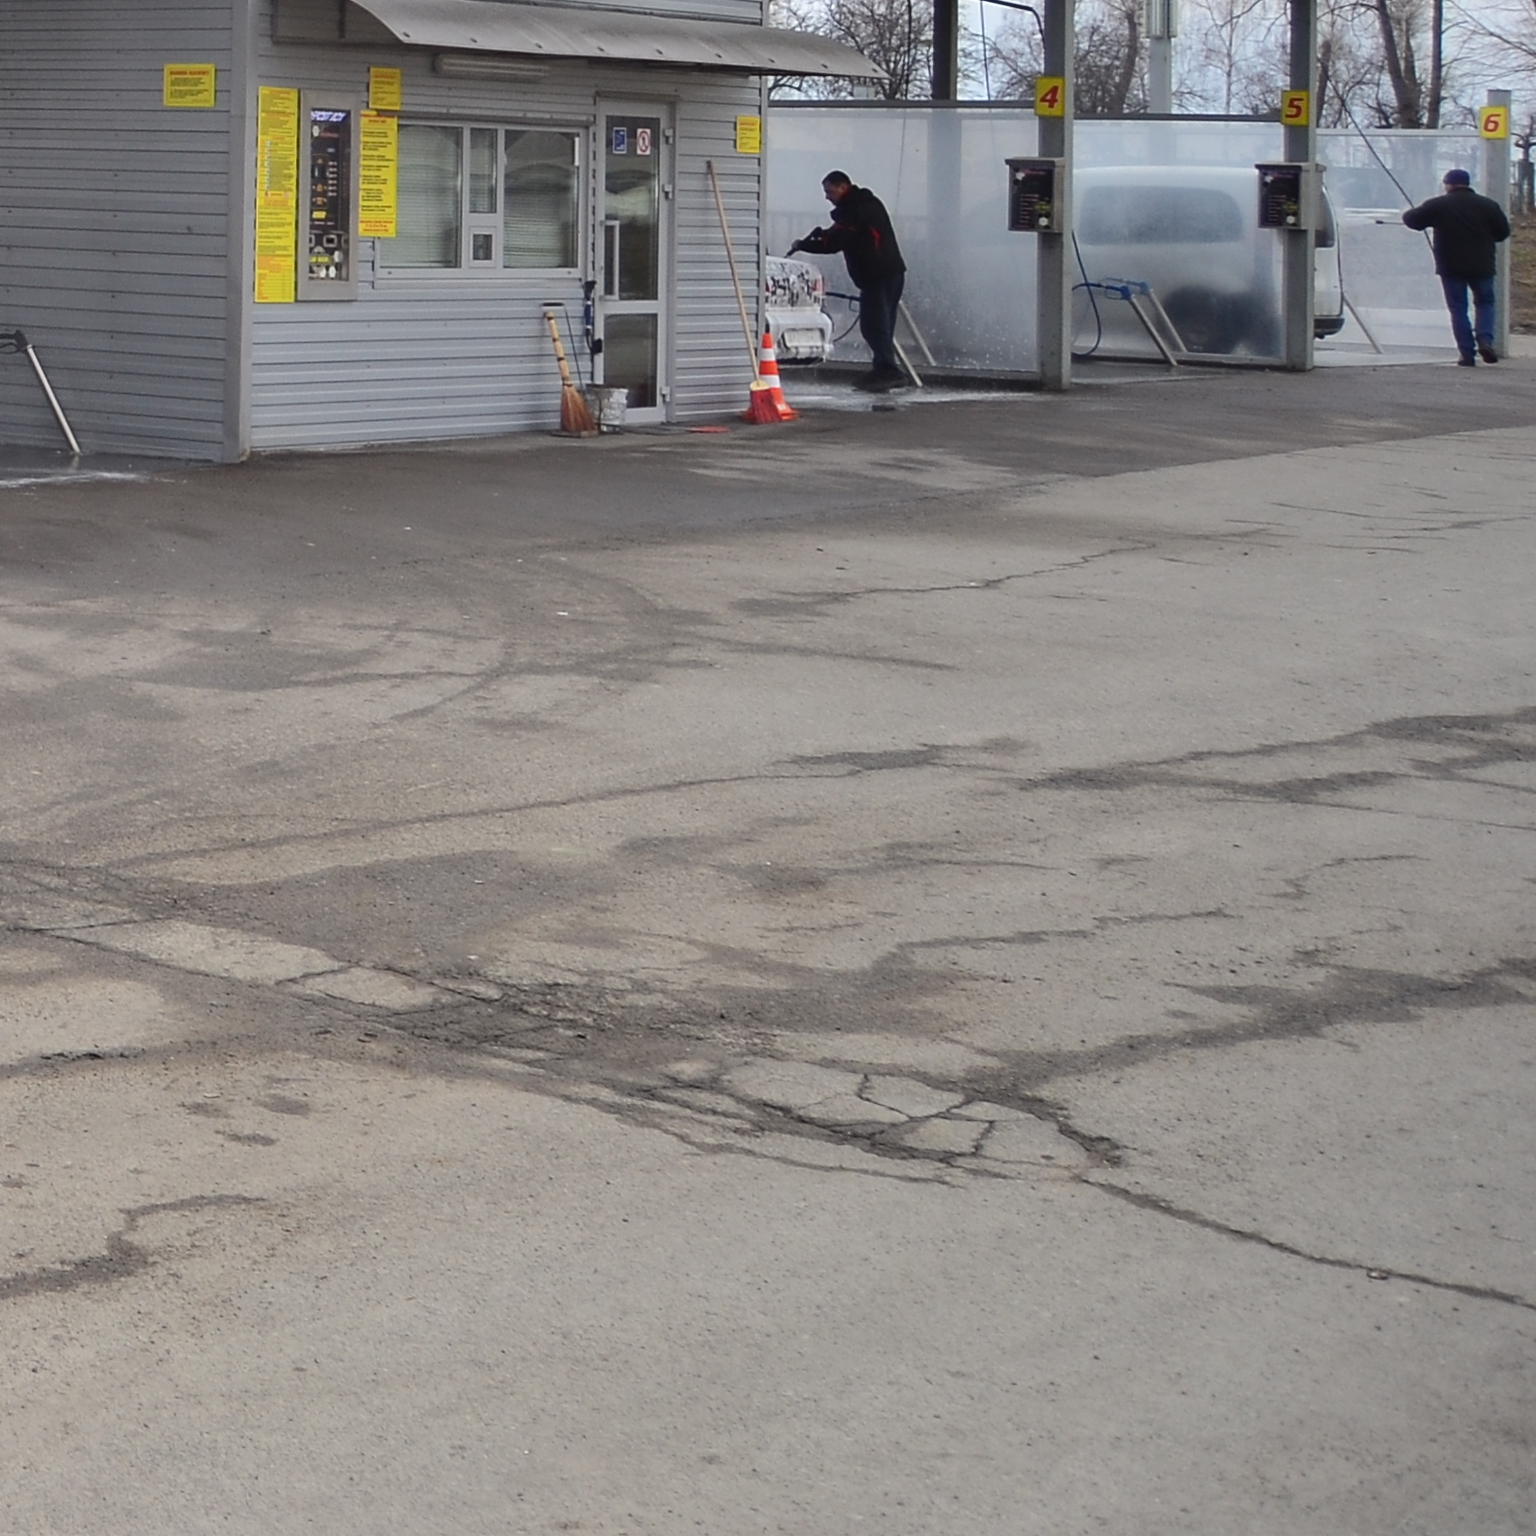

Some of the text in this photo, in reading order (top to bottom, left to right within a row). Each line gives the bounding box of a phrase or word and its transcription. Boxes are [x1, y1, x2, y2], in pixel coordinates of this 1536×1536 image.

[1039, 85, 1059, 109] 4
[1285, 98, 1304, 119] 5
[1483, 113, 1502, 133] 6
